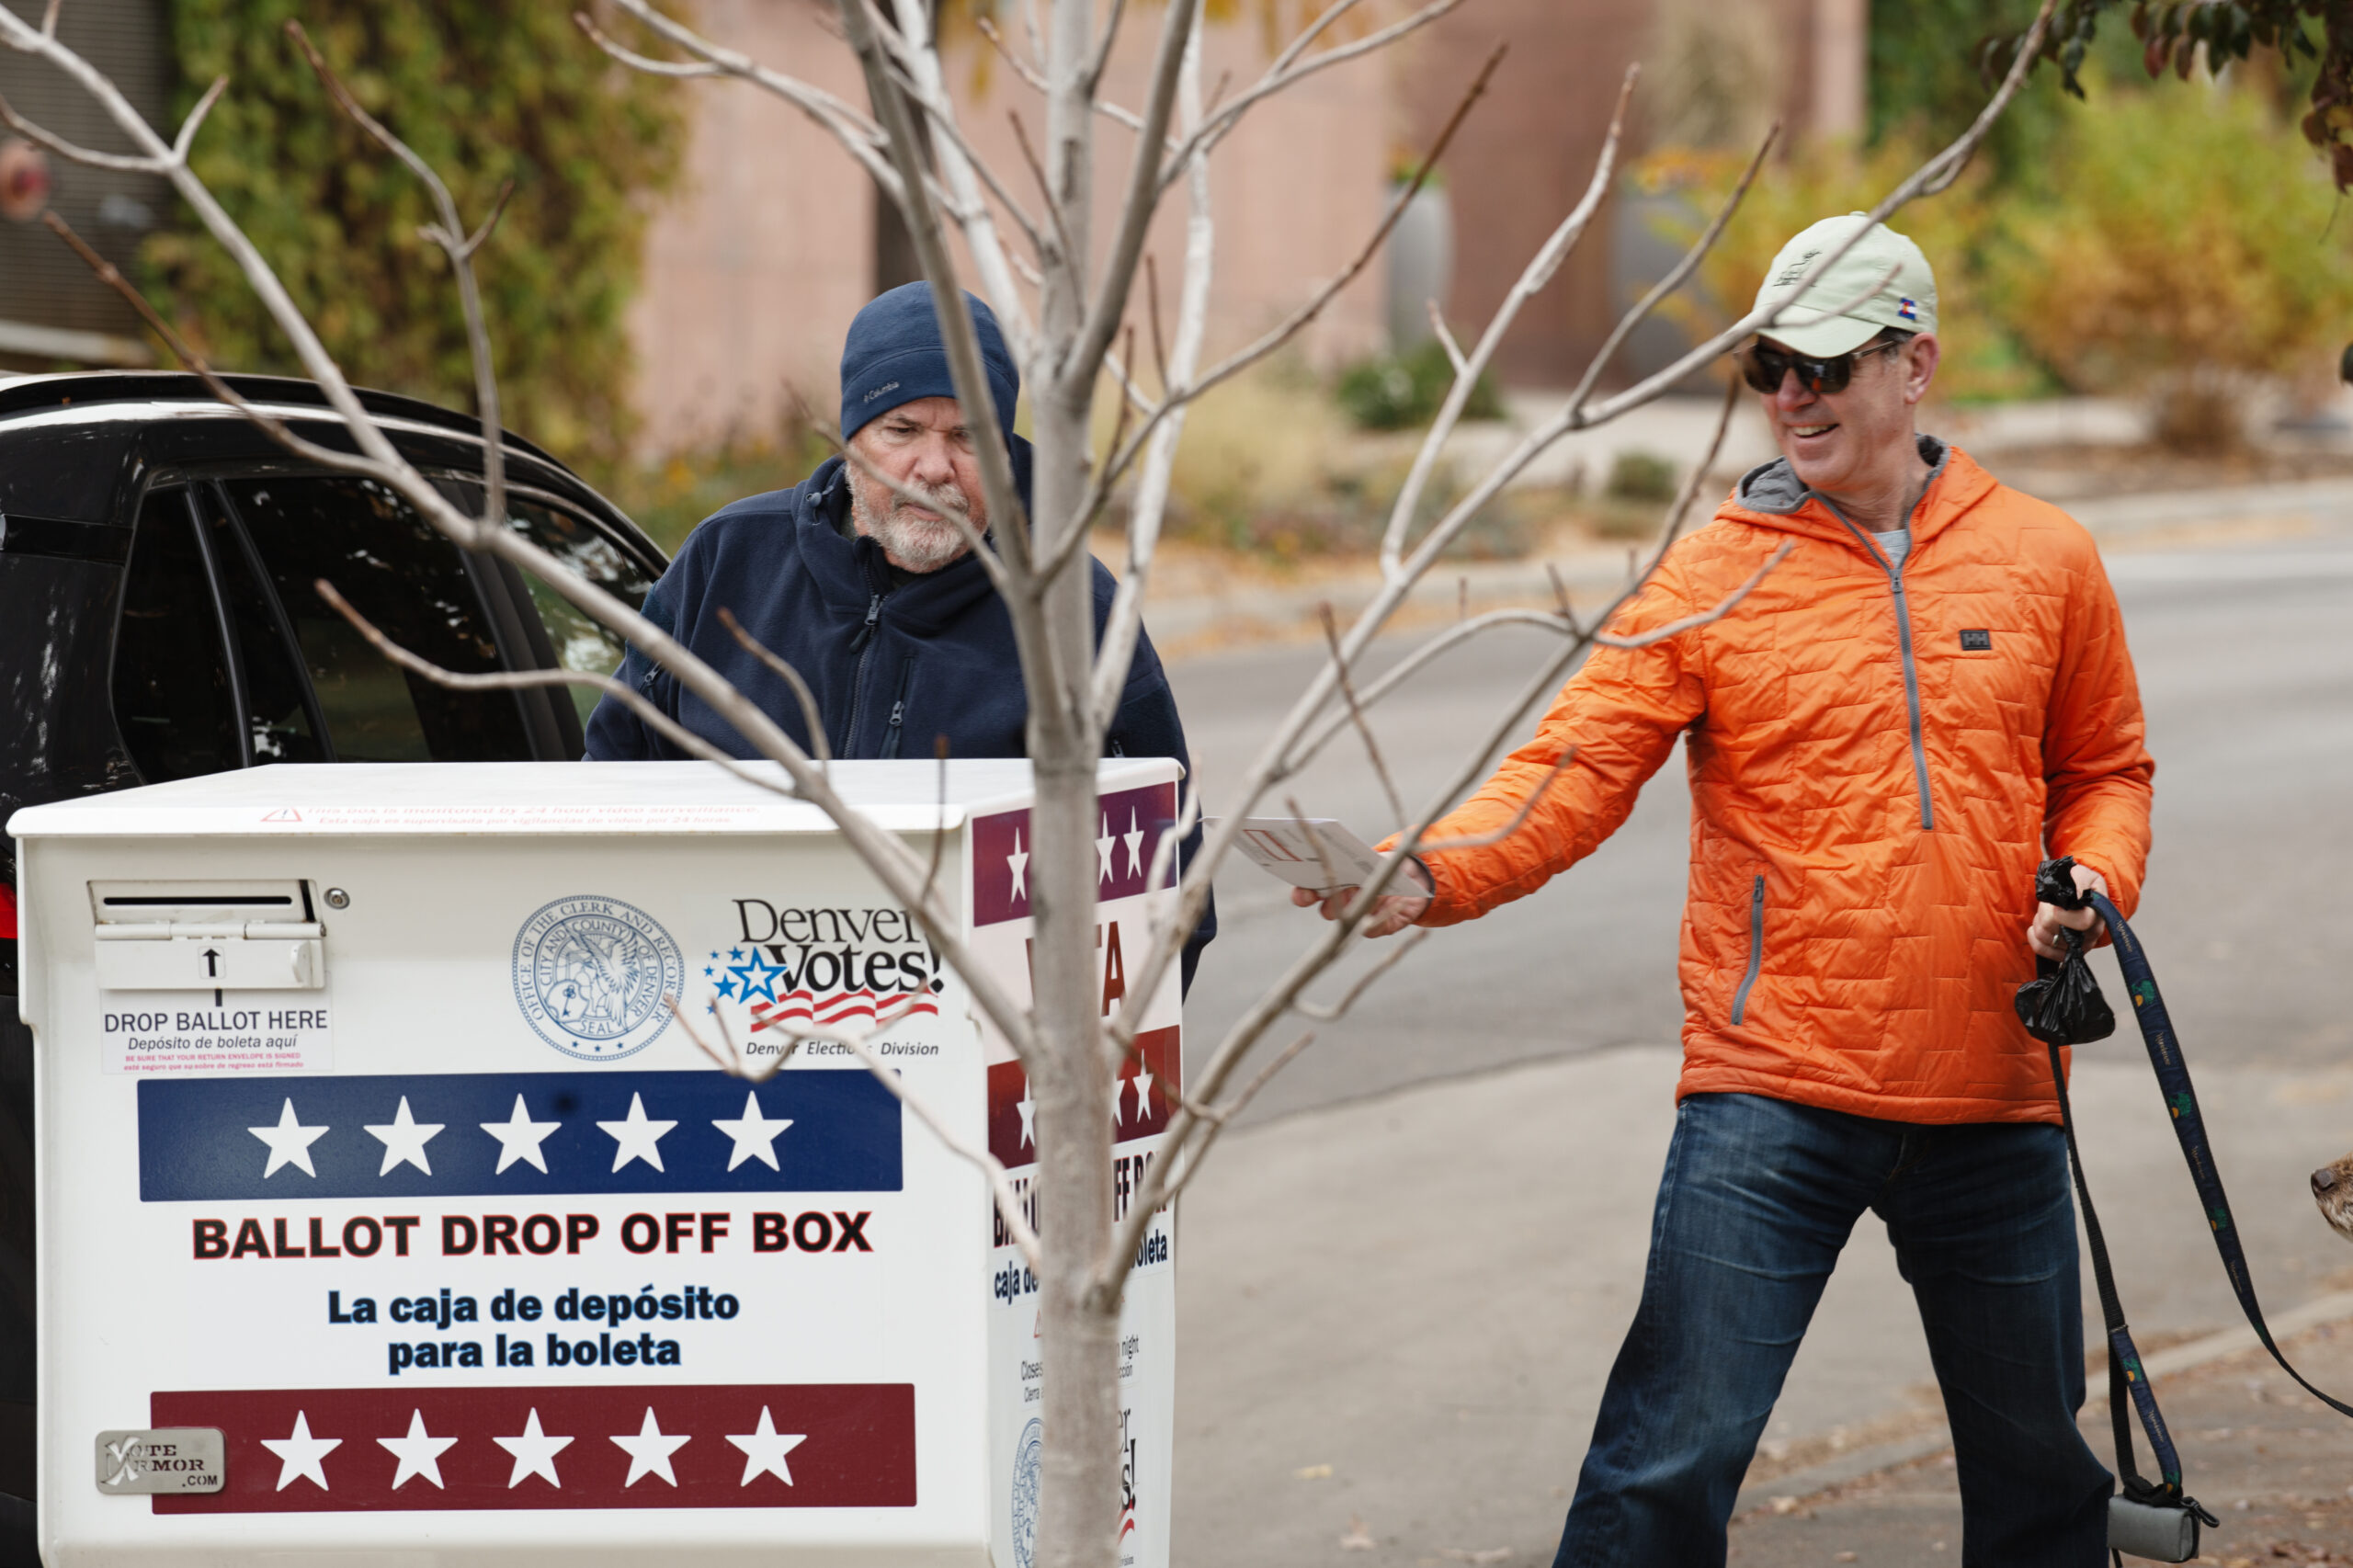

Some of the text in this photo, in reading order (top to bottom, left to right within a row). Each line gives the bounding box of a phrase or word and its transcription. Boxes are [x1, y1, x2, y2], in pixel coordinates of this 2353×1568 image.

[732, 898, 922, 944] Denver
[520, 902, 677, 1022] OFFICE OF THE CLERK AND RECORER
[540, 919, 657, 1018] CITY AND COUNTY OF DENVER
[765, 934, 944, 994] Votes!
[105, 1010, 328, 1032] DROP BALLOT HERE
[128, 1034, 298, 1051] Depósito de boleta aquí
[580, 1019, 613, 1034] SEAL
[746, 1040, 939, 1055] Denvr Electios Division
[192, 1210, 873, 1260] BALLOT DROP OFF BOX
[1131, 1229, 1167, 1269] oleta
[995, 1260, 1020, 1305] caja
[327, 1283, 740, 1331] La caja de depósito
[387, 1329, 681, 1376] para la boleta
[1122, 1335, 1140, 1359] night
[182, 1475, 218, 1487] .COM
